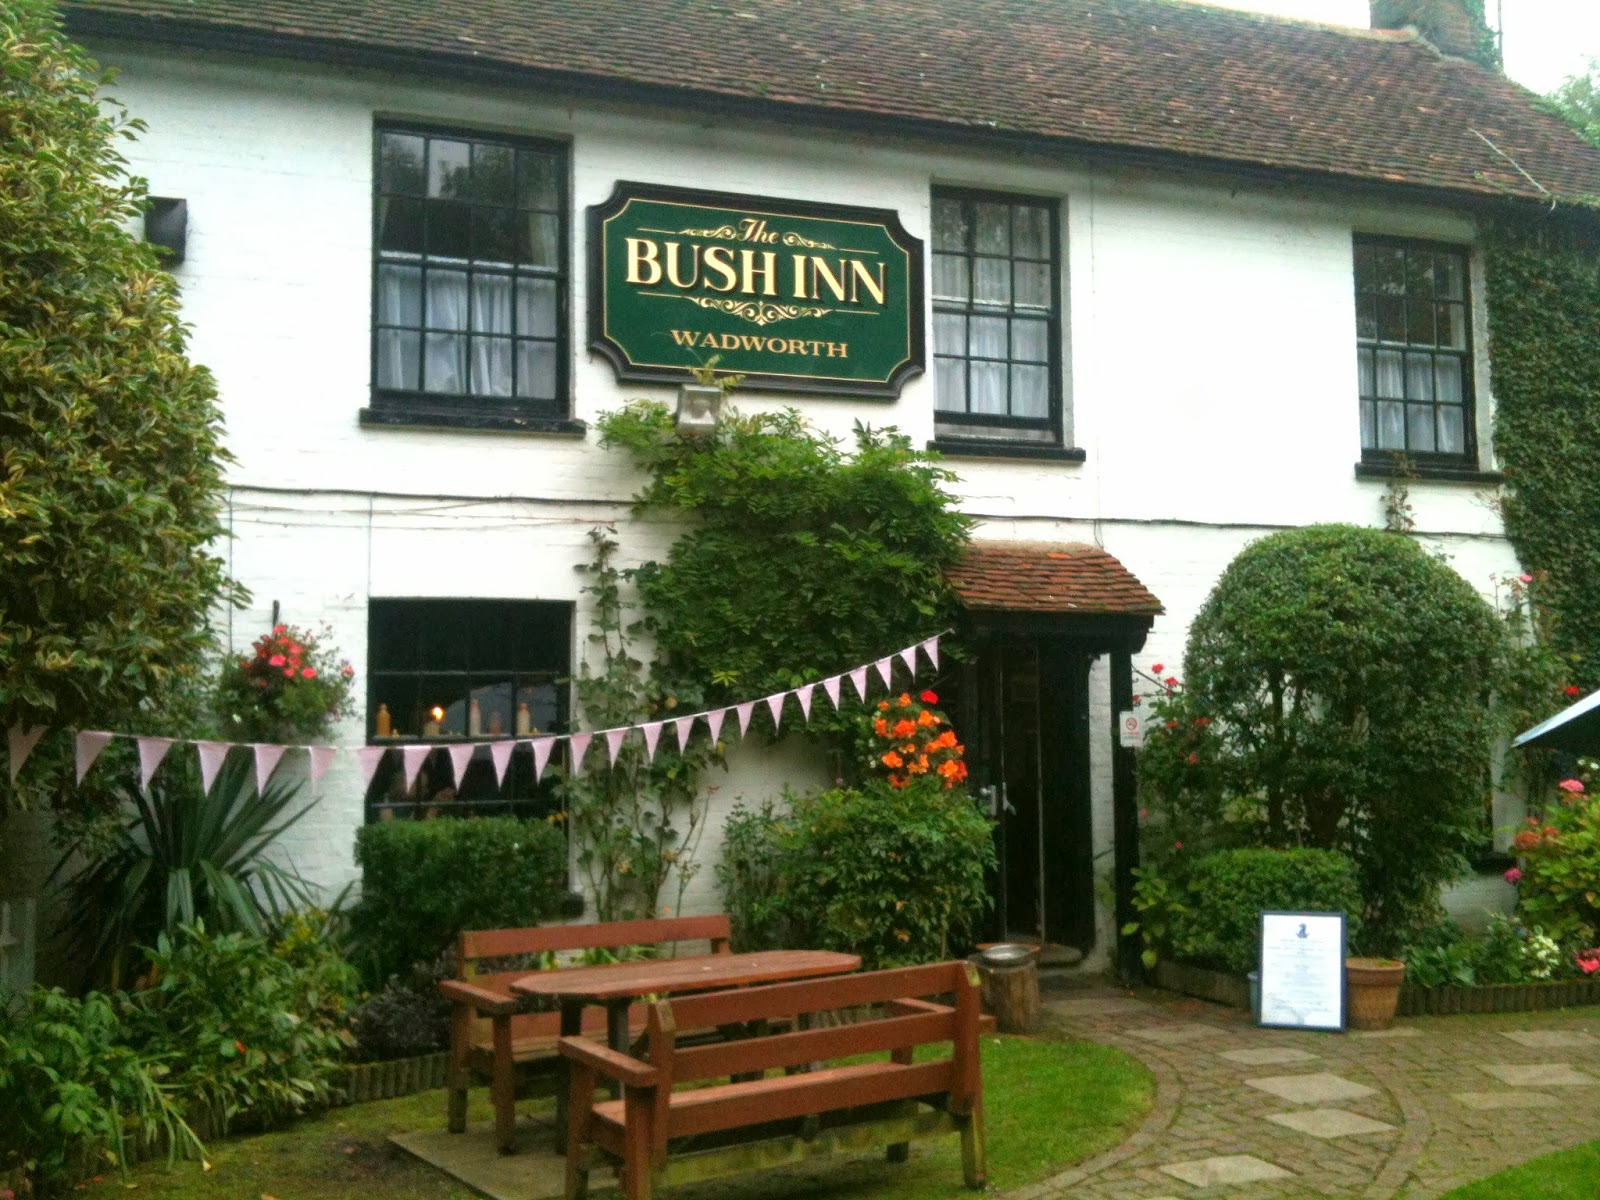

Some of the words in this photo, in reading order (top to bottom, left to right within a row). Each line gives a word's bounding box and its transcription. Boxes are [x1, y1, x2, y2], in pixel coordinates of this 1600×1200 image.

[737, 218, 779, 246] The
[624, 237, 778, 297] BUSH
[792, 254, 886, 305] INN
[670, 329, 849, 358] WADWORTH
